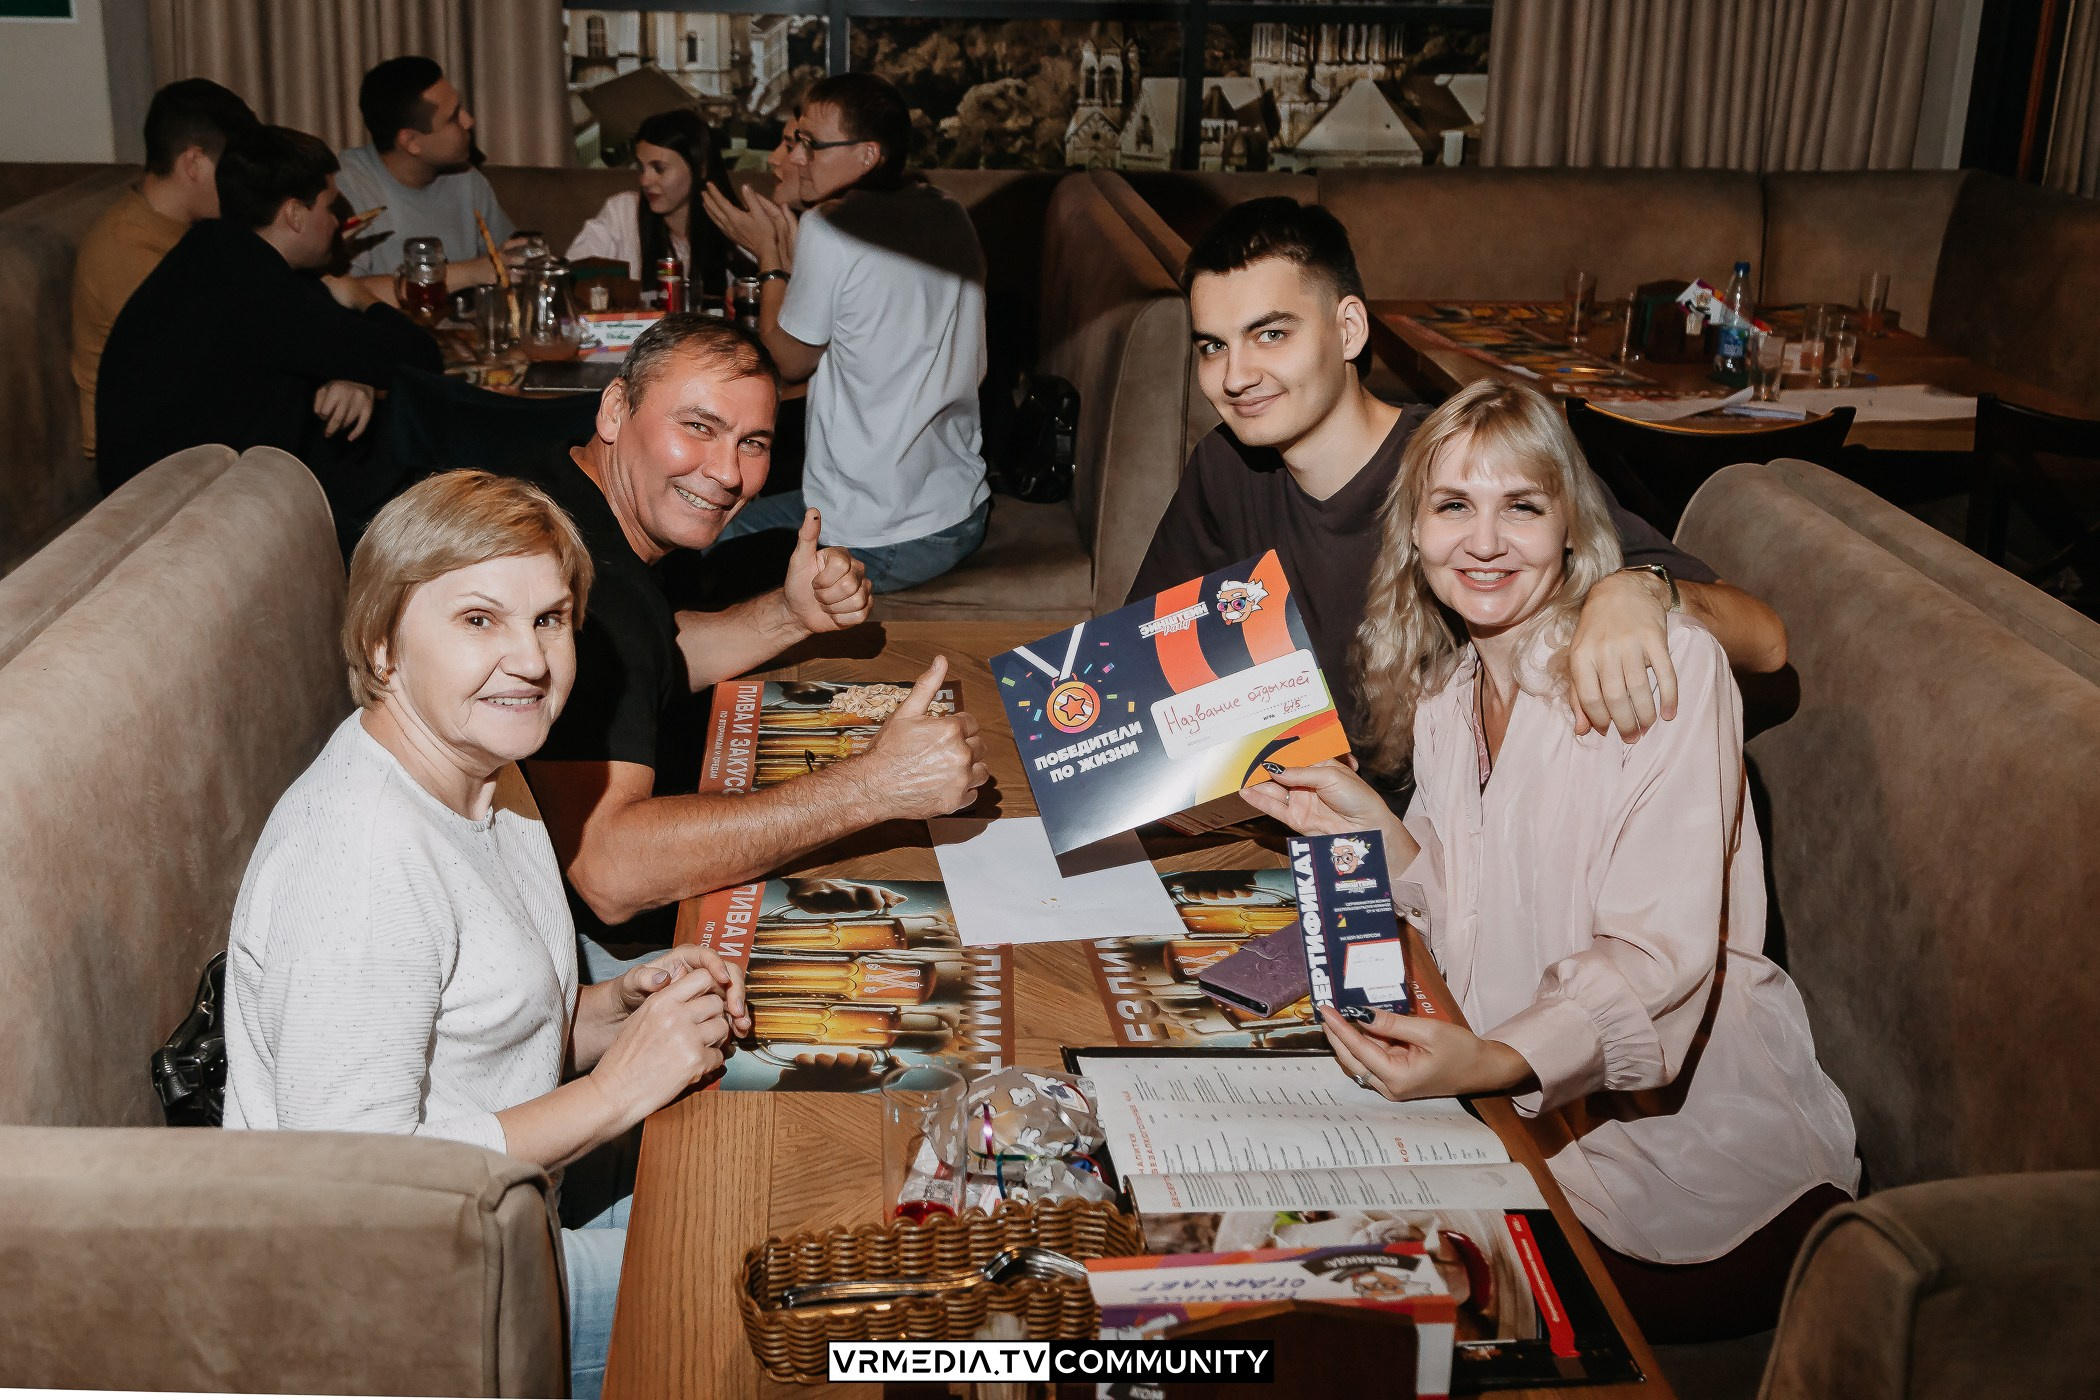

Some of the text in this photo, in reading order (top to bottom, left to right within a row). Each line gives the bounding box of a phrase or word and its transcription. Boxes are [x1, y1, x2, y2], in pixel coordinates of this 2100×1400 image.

[719, 710, 728, 718] ПО
[733, 685, 758, 722] ПИВА
[1163, 698, 1241, 735] Название
[731, 723, 753, 734] И
[1034, 720, 1143, 771] ПОБЕДИТЕЛИ
[1049, 740, 1139, 783] ПО ЖИЗНИ
[704, 921, 716, 932] ПО
[717, 884, 758, 957] ПИВА И
